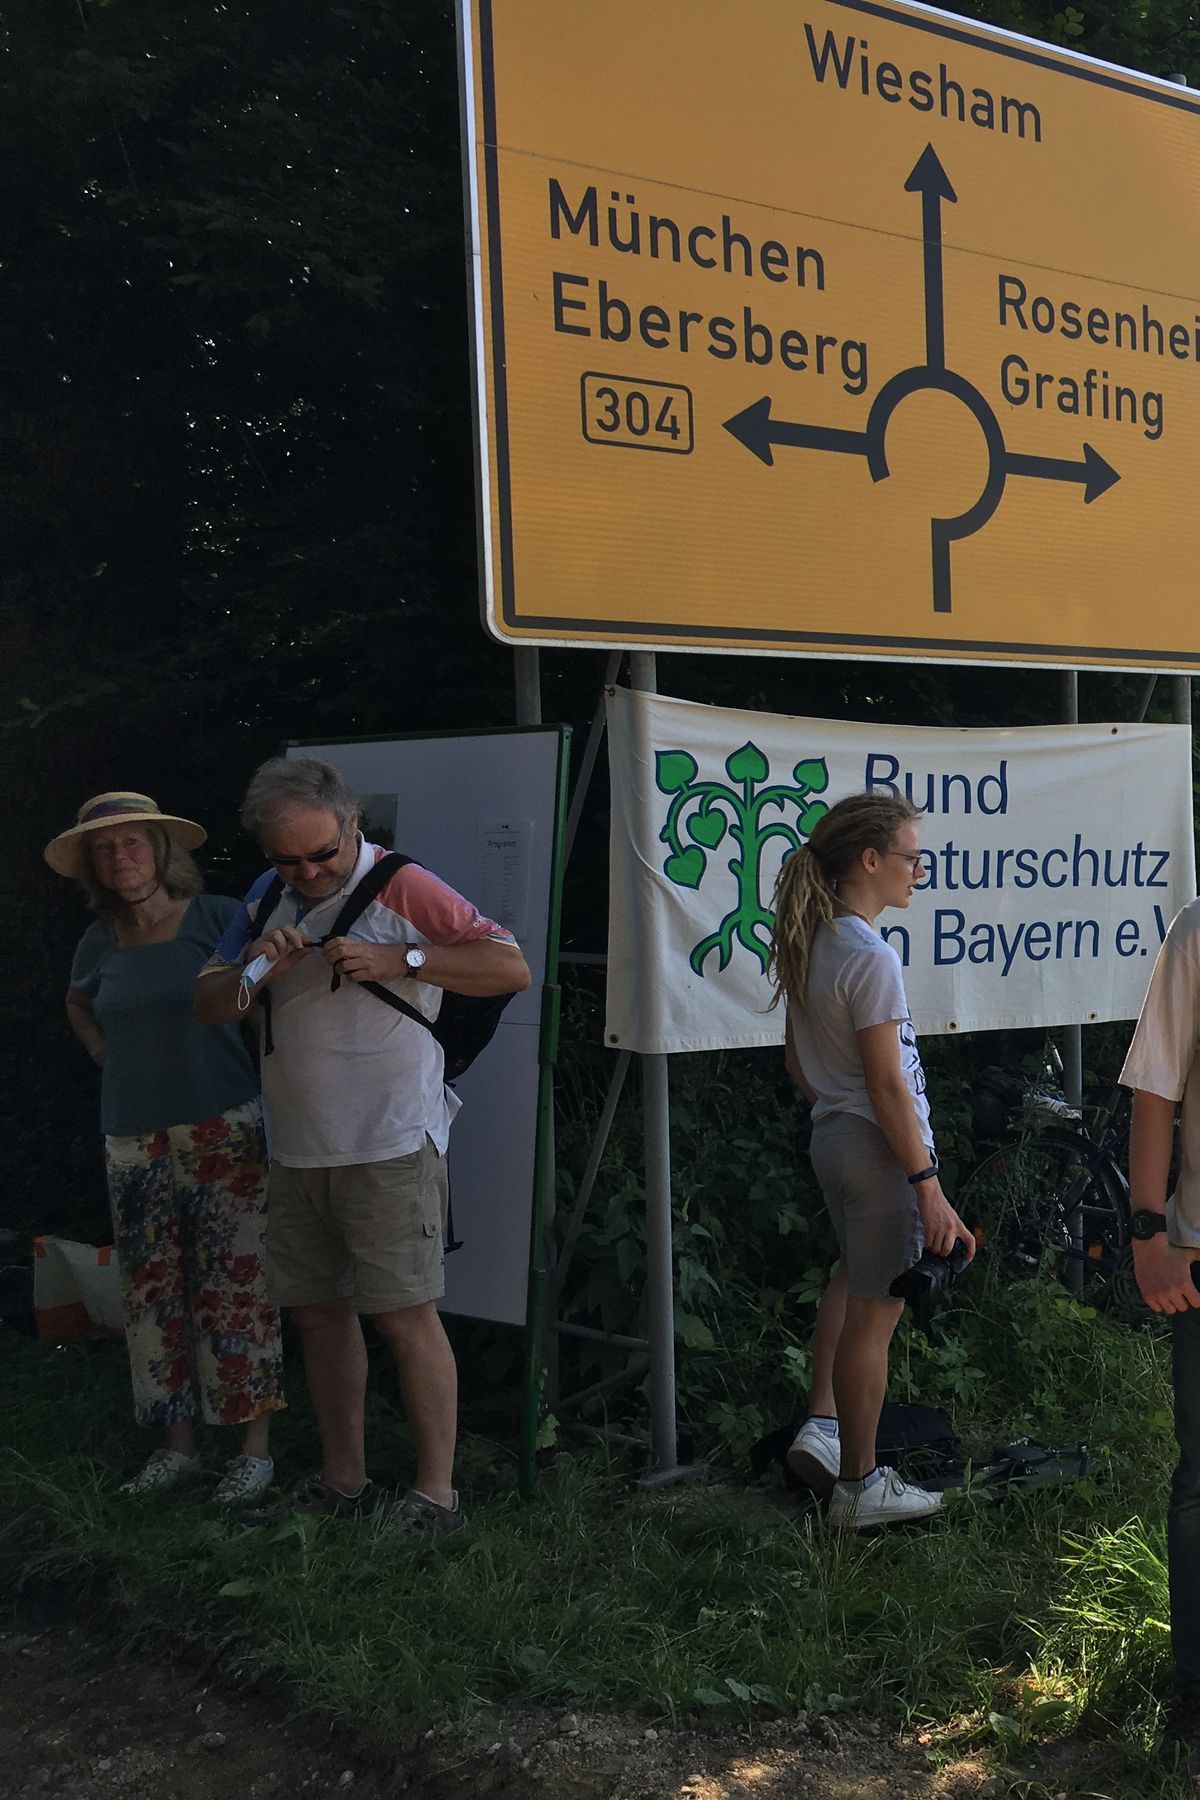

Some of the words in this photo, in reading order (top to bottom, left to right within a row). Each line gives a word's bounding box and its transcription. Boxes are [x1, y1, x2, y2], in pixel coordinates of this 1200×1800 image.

[804, 23, 1042, 143] Wiesham
[549, 177, 826, 291] München
[552, 271, 868, 396] Ebersberg
[595, 386, 681, 441] 304
[1001, 354, 1163, 440] Grafing
[865, 753, 1008, 815] Bund
[912, 833, 1171, 891] aturschutz
[933, 908, 1101, 977] Bayern
